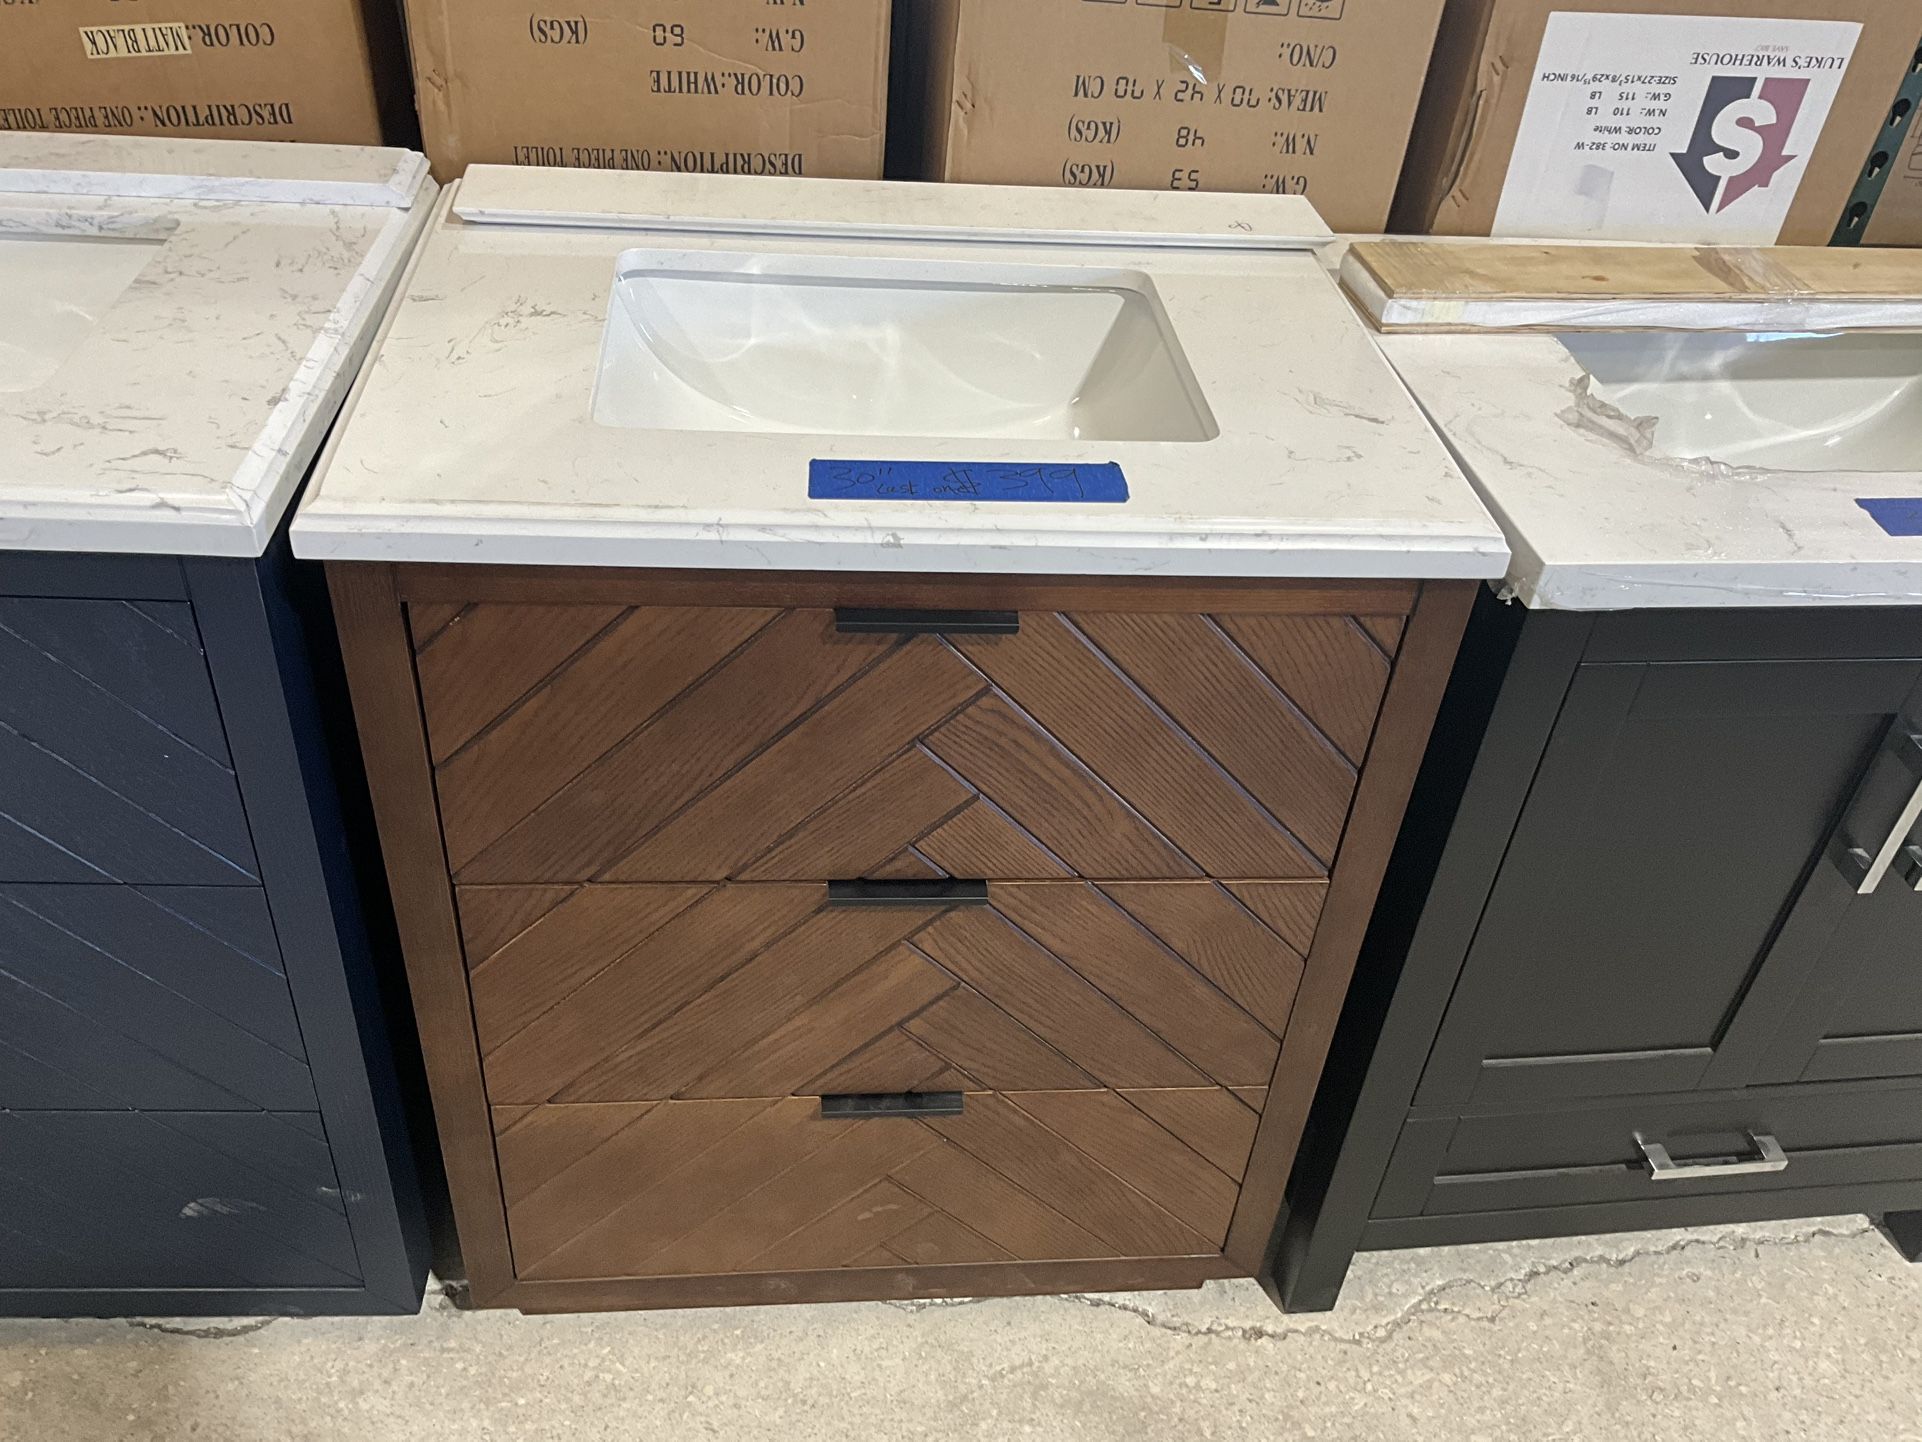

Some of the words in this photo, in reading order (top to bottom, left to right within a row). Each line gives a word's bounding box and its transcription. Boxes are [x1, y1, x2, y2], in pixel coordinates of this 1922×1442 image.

[140, 25, 188, 55] MATT
[529, 13, 588, 45] (KGS)
[652, 23, 684, 46] 60
[82, 28, 141, 56] BLACK
[1689, 52, 1787, 68] WAREHOUSE
[1791, 55, 1845, 70] LUKE'S
[1073, 74, 1105, 99] CM
[1115, 76, 1145, 99] 70
[1541, 73, 1569, 82] INCH
[1174, 80, 1204, 102] 42
[1231, 85, 1261, 108] 70
[1267, 87, 1328, 113] MEAS:
[1589, 91, 1603, 100] LB
[1618, 92, 1637, 101] 115
[0, 107, 49, 130] TOILE
[49, 106, 98, 129] PIECE
[98, 105, 133, 128] ONE
[1586, 107, 1599, 116] LB
[1612, 107, 1631, 116] 110
[1067, 117, 1121, 144] (KGS)
[1175, 126, 1205, 149] 48
[1593, 125, 1622, 135] White
[1625, 126, 1662, 136] COLOR:
[512, 146, 571, 168] TOILET
[1574, 141, 1608, 151] 382-W
[1610, 142, 1629, 152] NO:
[1631, 142, 1657, 152] ITEM
[572, 147, 616, 169] PIECE
[620, 148, 651, 170] ONE
[1062, 159, 1115, 187] (KGS)
[1170, 168, 1200, 191] 53
